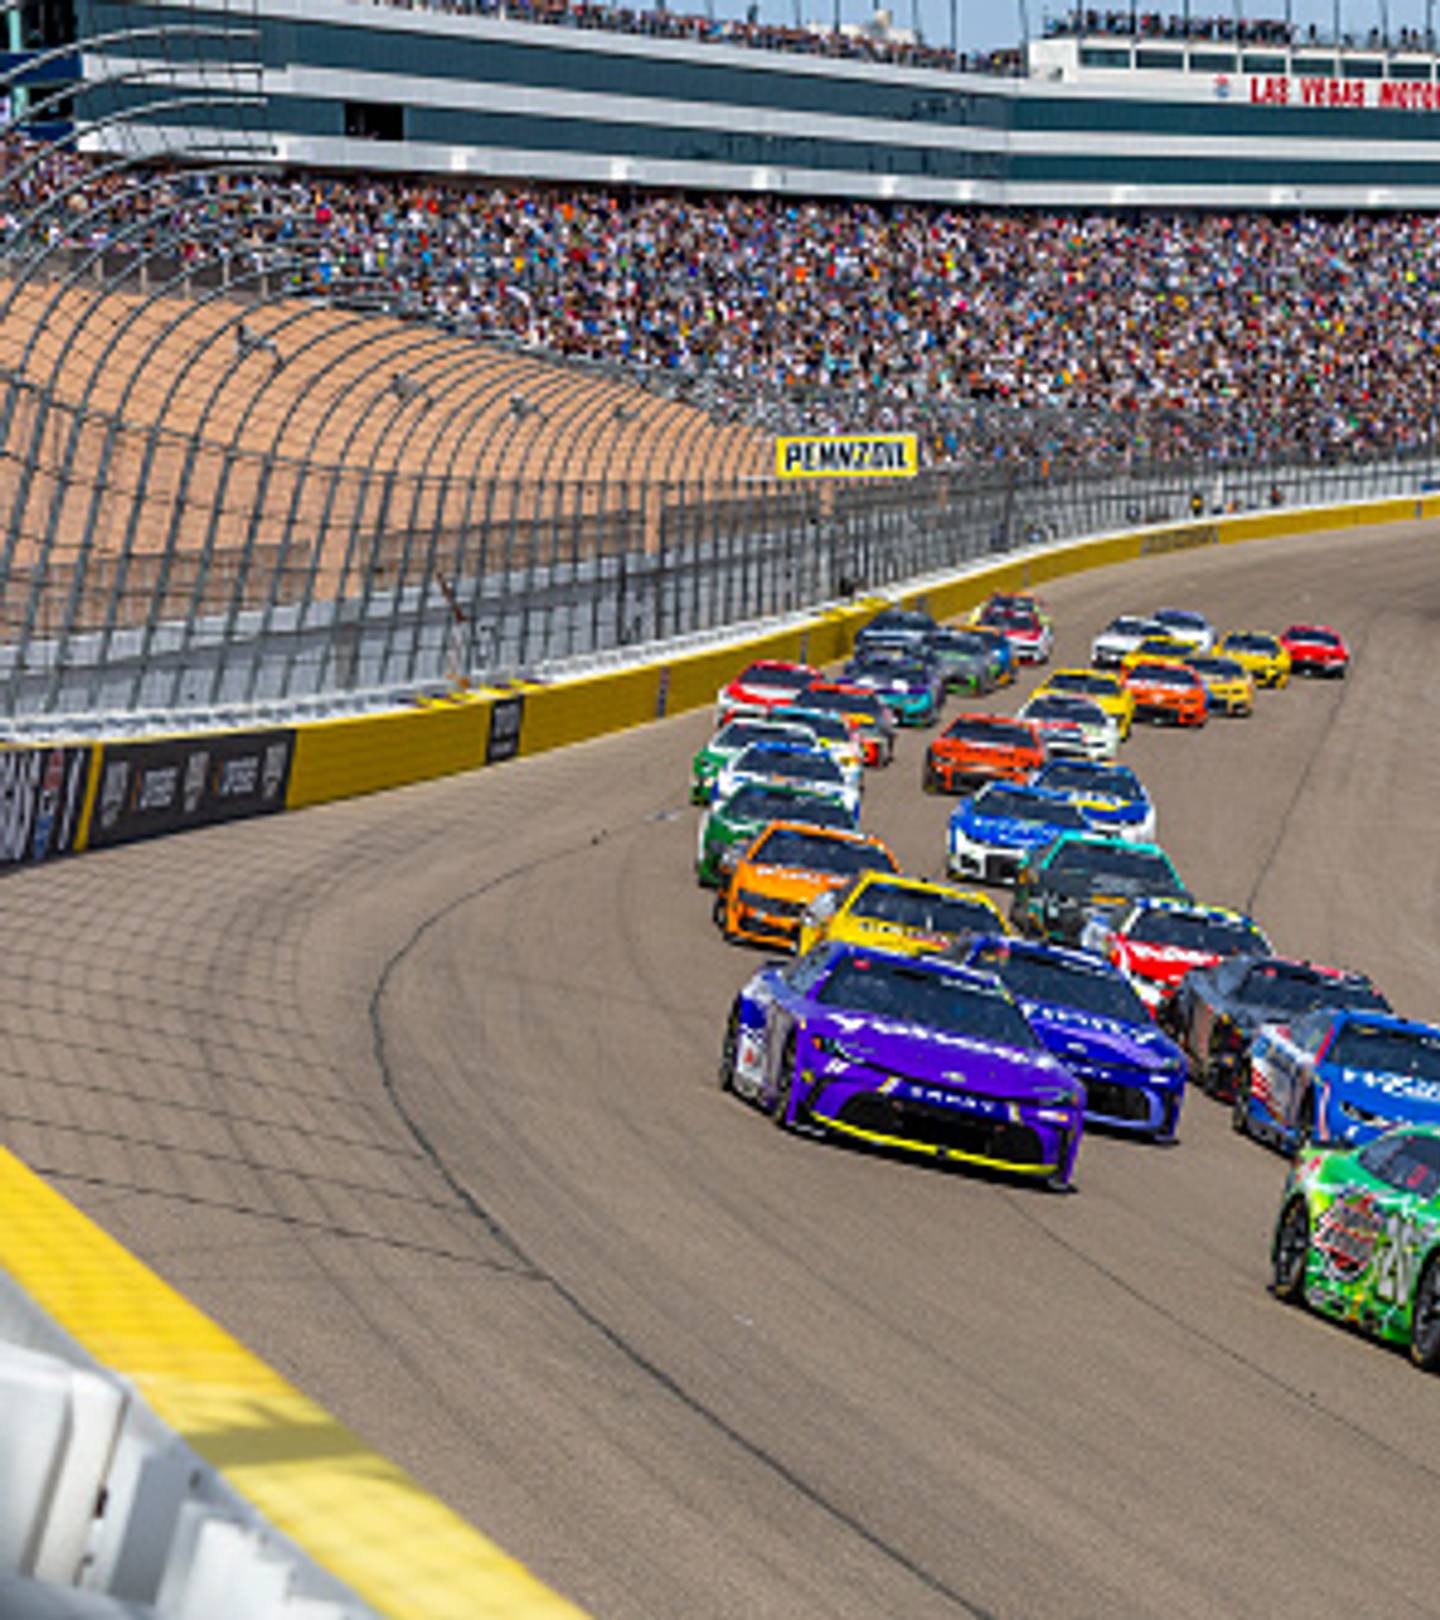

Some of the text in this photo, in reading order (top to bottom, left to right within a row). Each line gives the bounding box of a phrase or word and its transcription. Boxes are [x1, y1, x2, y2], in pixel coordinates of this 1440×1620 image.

[1250, 77, 1288, 105] LAS
[1300, 78, 1365, 107] VEGAS
[785, 441, 906, 471] PENNZOIL
